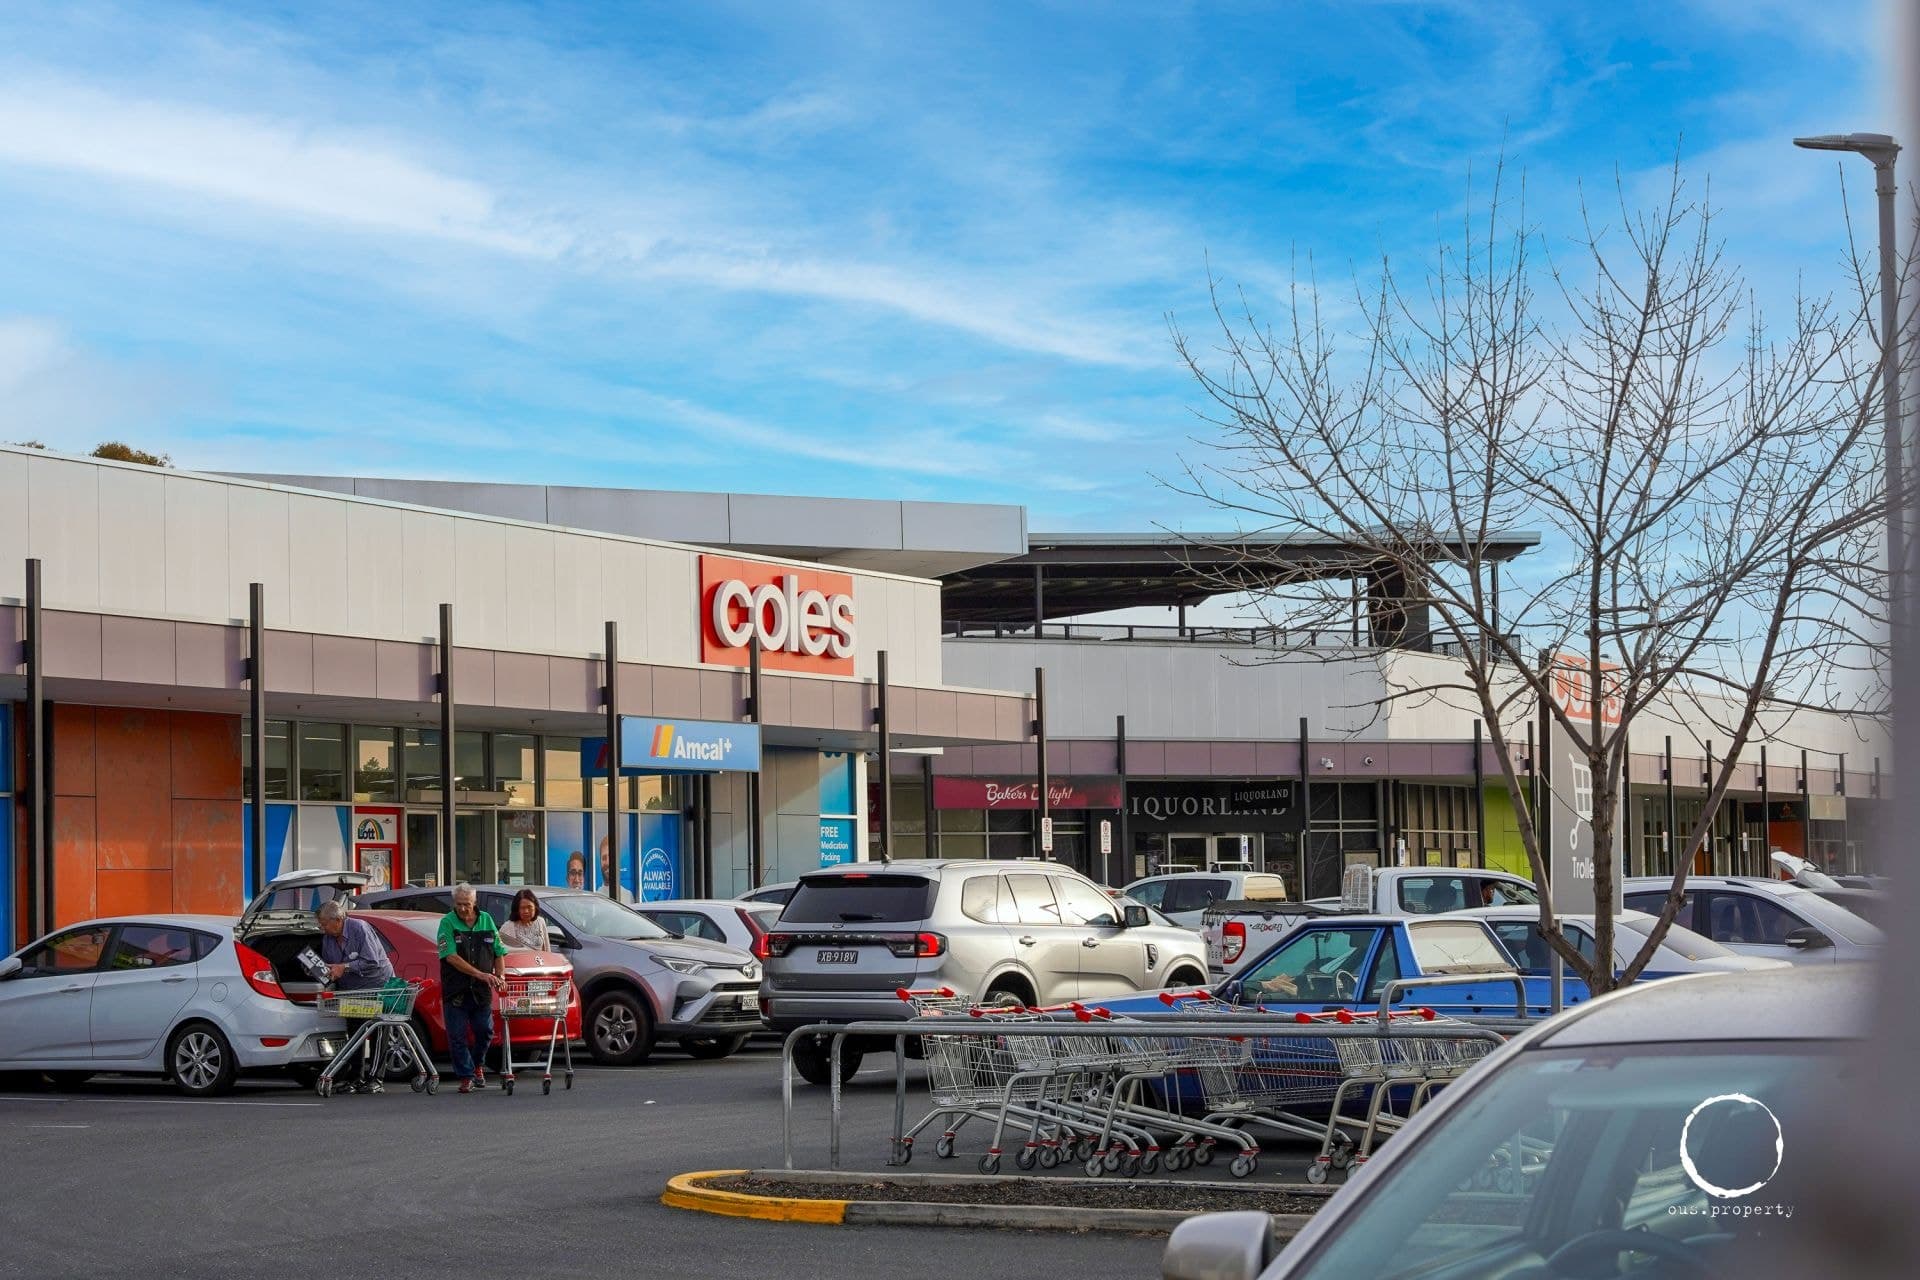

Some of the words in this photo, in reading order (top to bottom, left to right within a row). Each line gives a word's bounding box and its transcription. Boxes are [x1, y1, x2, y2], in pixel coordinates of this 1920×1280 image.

[713, 575, 858, 659] coles
[985, 784, 1027, 806] Bakers
[1031, 784, 1073, 805] Dlight
[1234, 788, 1289, 803] LIQUORLAND
[1116, 796, 1287, 821] IQUORL
[820, 826, 839, 838] FREE
[821, 841, 849, 850] Medication
[821, 852, 841, 864] Packing
[643, 871, 671, 881] ALWAYS
[643, 882, 671, 890] AVAILABLE
[305, 949, 331, 976] PEPS
